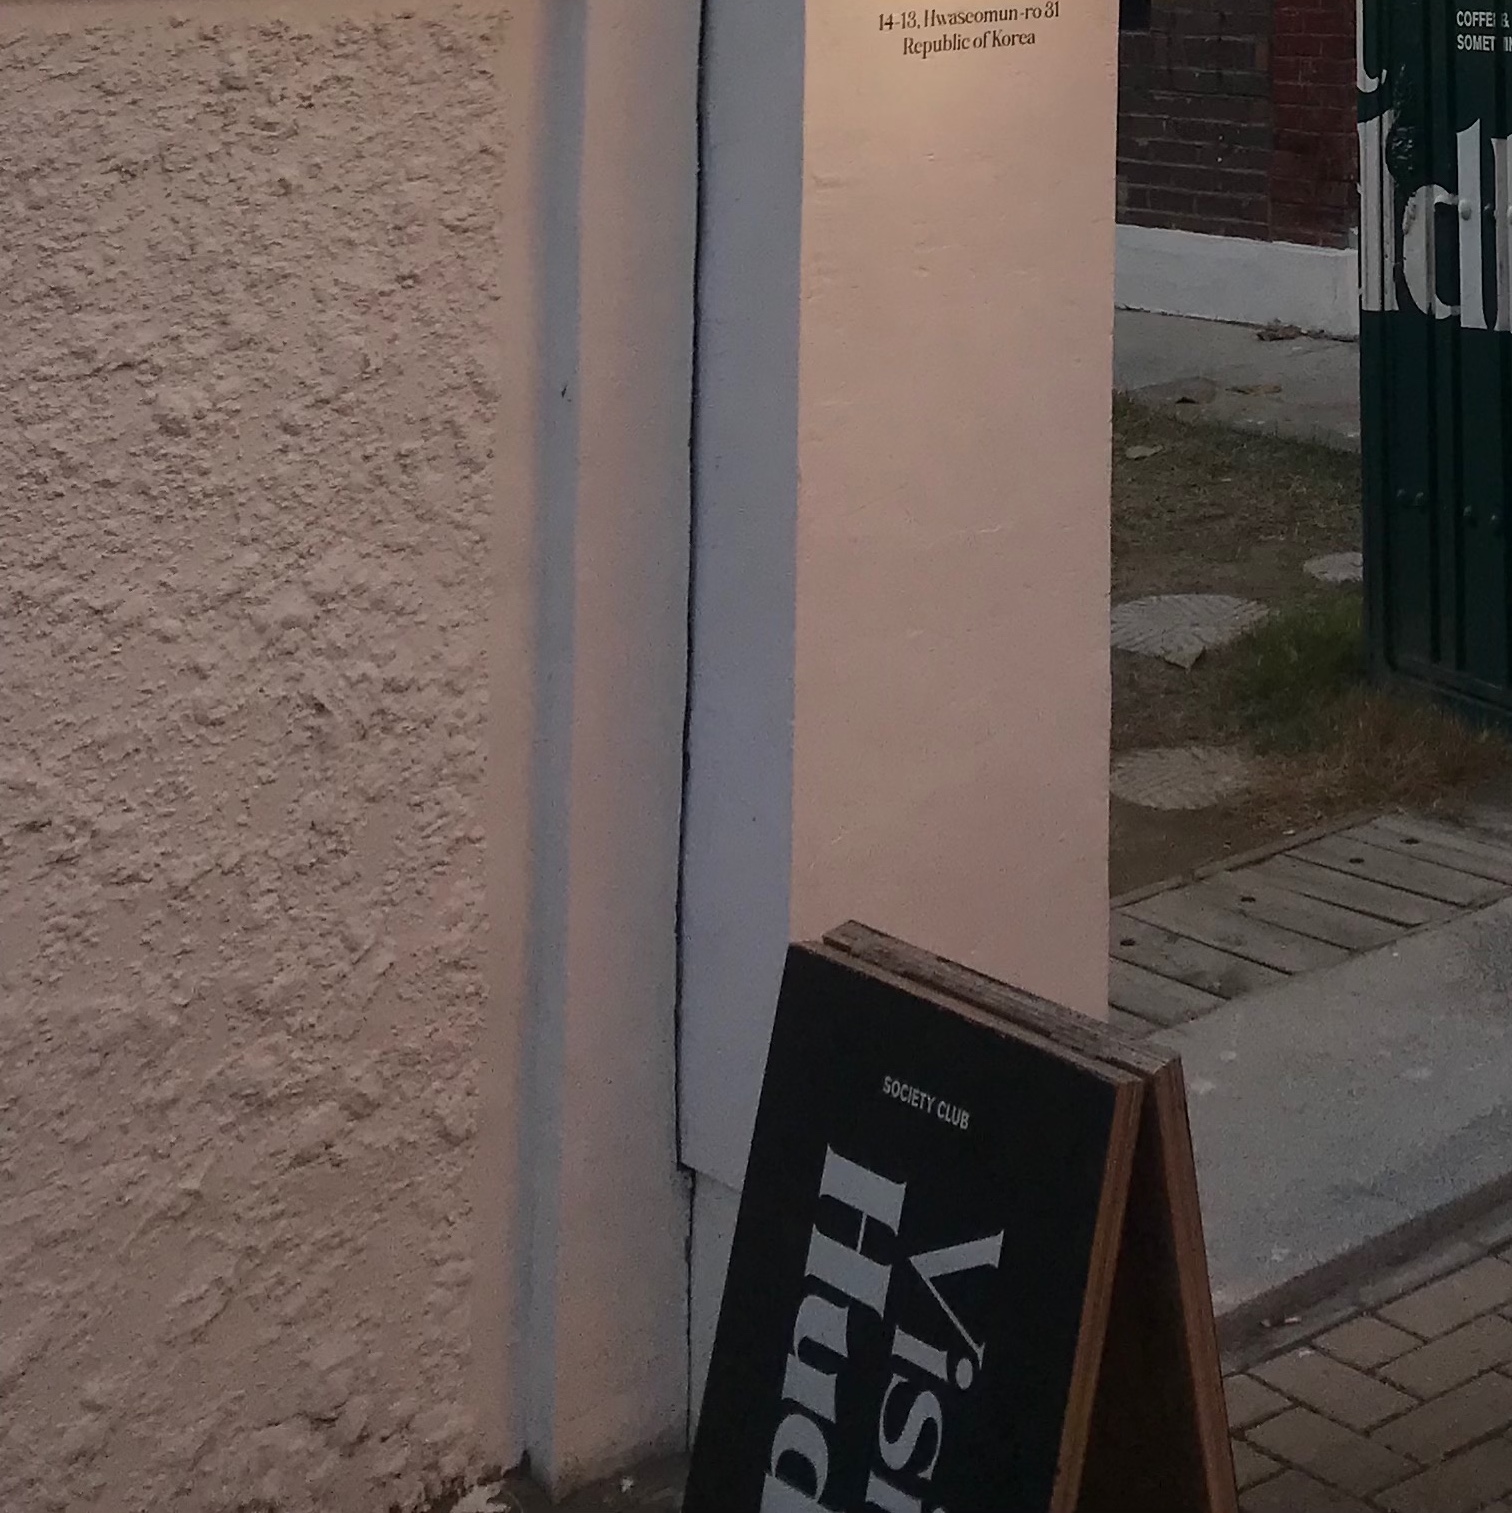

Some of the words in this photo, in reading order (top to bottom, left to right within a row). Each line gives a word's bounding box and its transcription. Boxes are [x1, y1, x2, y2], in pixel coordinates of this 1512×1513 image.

[878, 10, 921, 31] 14-13,
[1044, 0, 1060, 18] 31
[1501, 12, 1510, 28] &
[902, 33, 970, 60] Republic
[972, 29, 990, 49] of
[992, 28, 1036, 48] Korea
[882, 1075, 937, 1114] SOCIETY
[936, 1100, 970, 1130] CLUB
